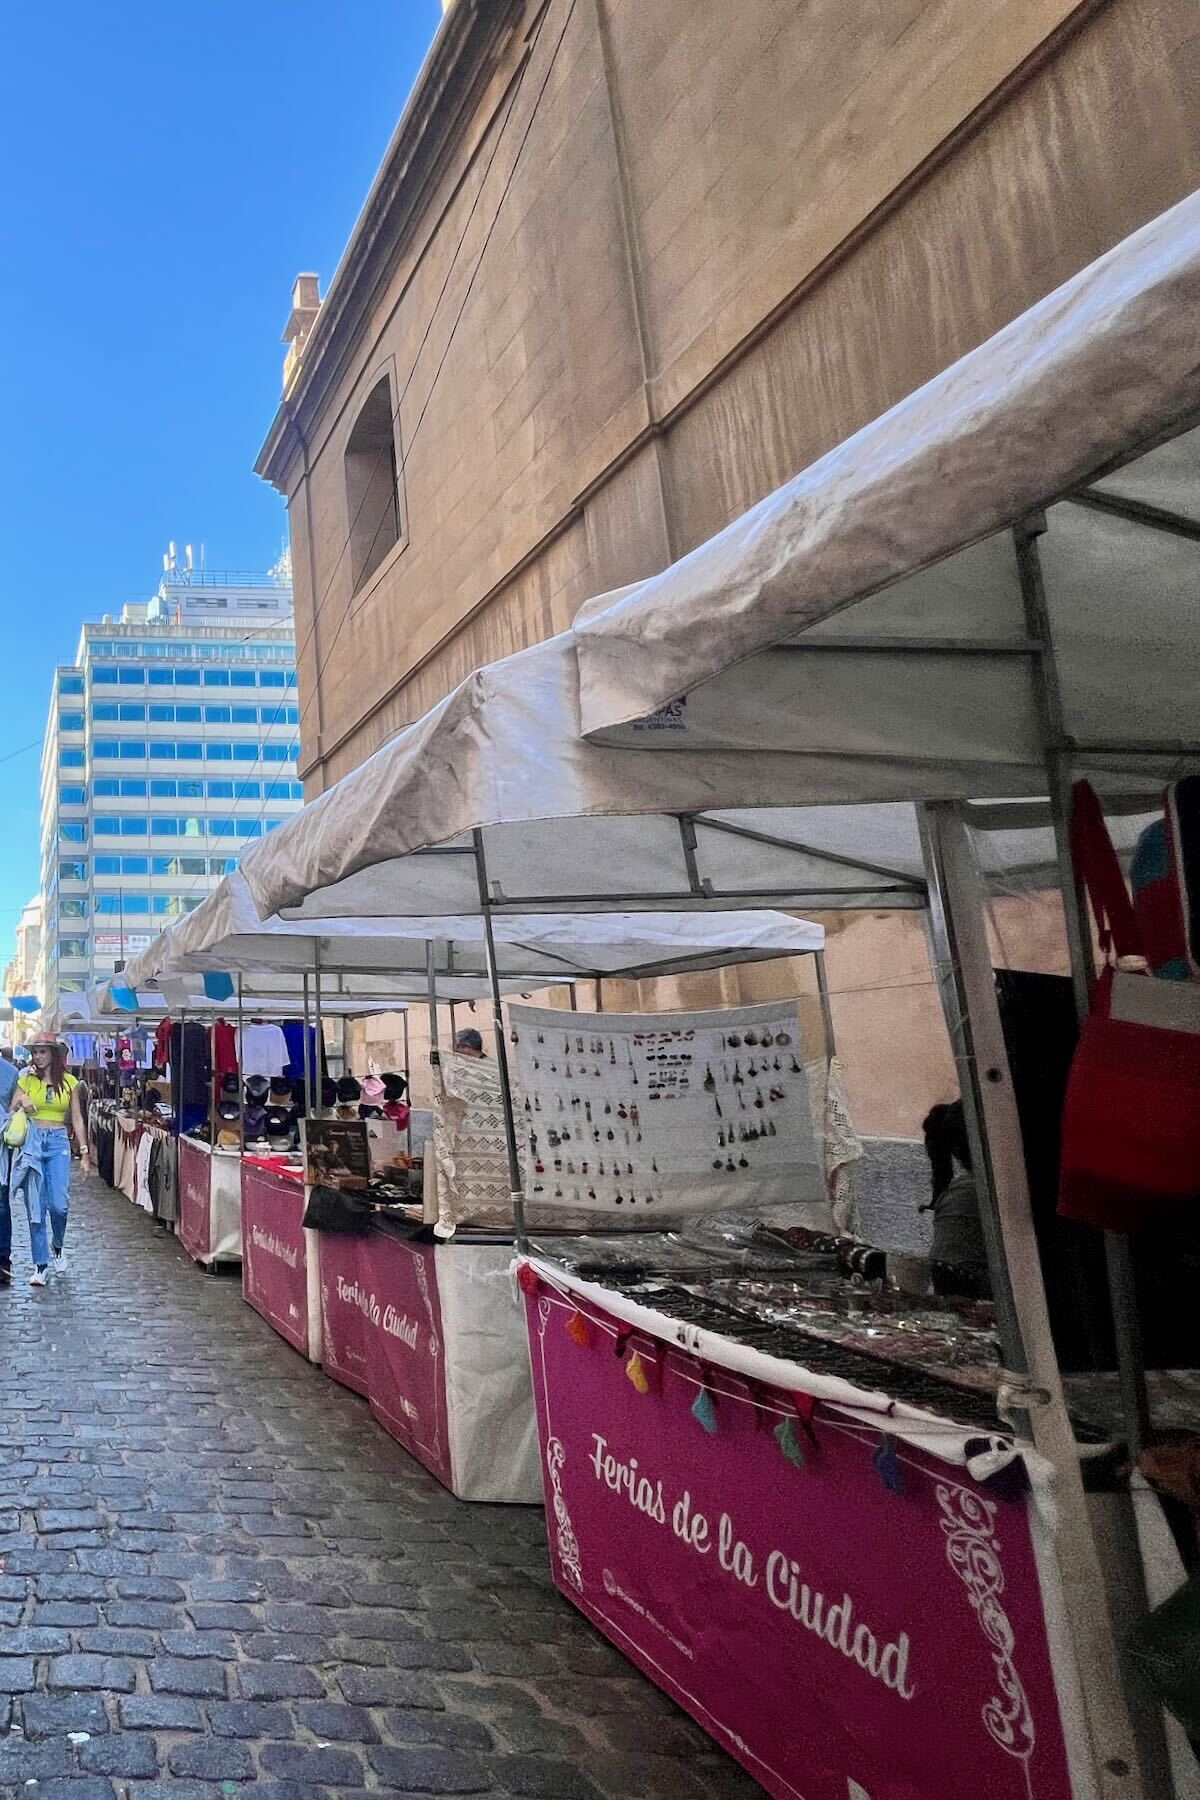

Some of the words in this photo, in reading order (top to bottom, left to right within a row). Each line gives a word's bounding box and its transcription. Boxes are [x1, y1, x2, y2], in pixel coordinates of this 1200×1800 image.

[383, 1304, 419, 1350] Ciudad
[589, 1433, 666, 1525] Ferias
[672, 1490, 712, 1554] de
[718, 1512, 758, 1588] la
[766, 1550, 916, 1701] Ciudad
